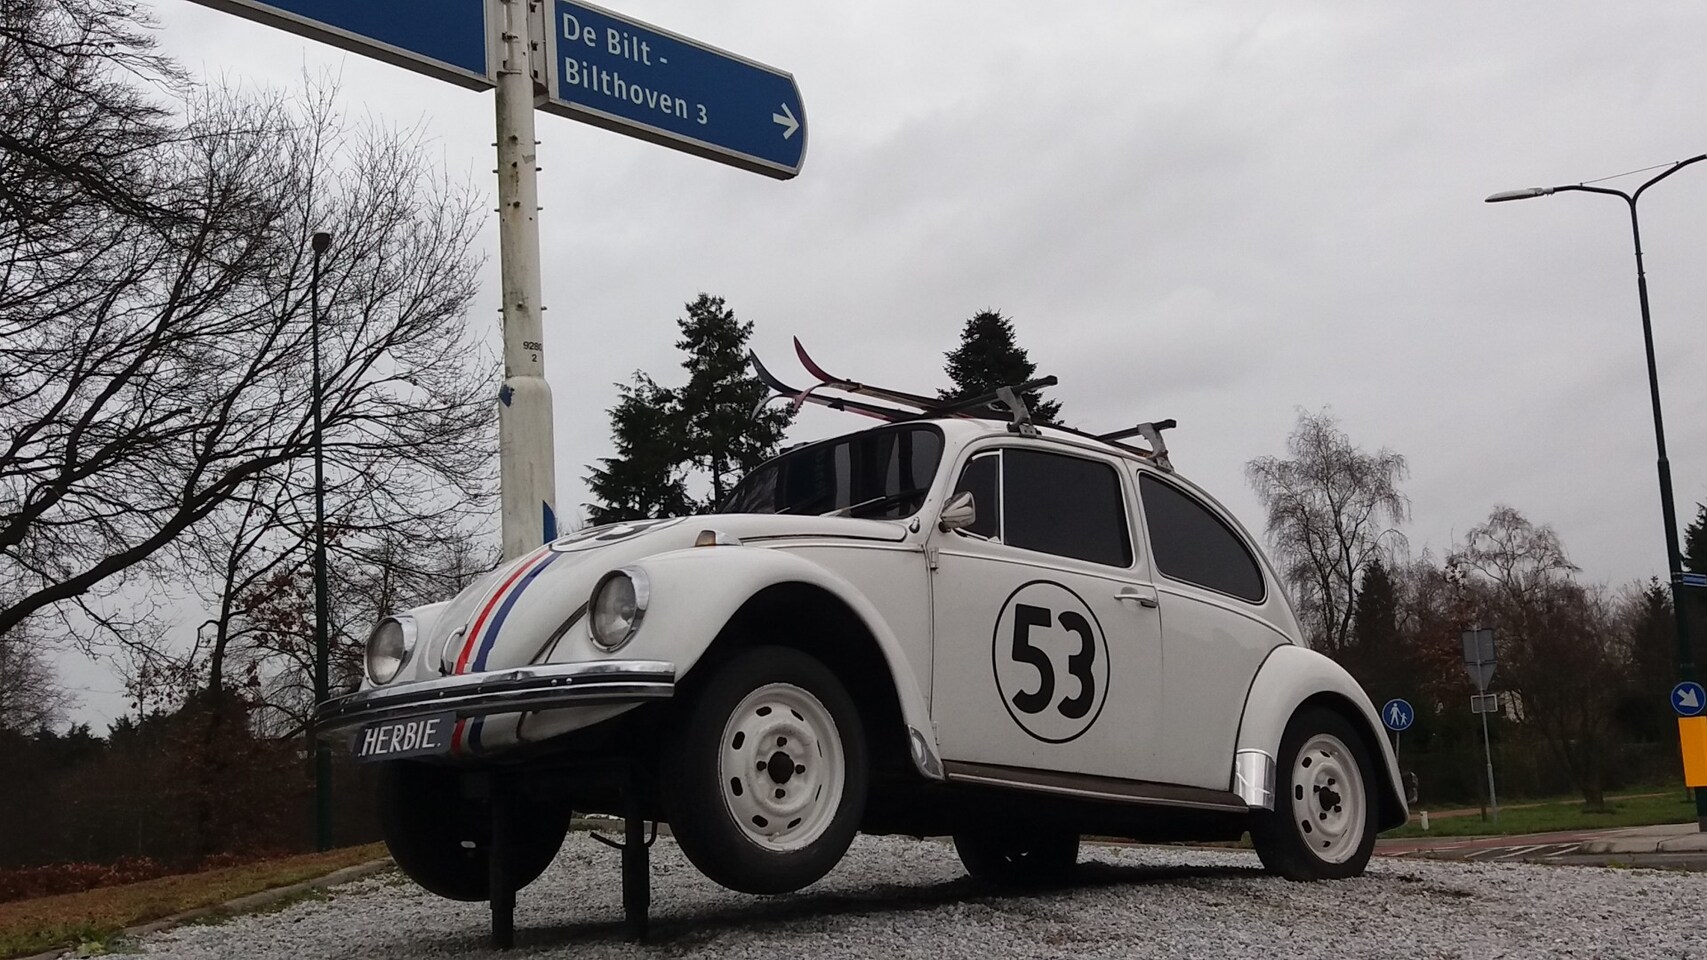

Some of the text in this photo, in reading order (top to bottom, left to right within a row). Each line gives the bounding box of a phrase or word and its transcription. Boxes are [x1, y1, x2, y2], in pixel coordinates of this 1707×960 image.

[563, 13, 597, 47] De
[607, 28, 651, 66] Bilt
[565, 57, 708, 125] Bilthoven 3
[531, 353, 538, 362] 2
[1012, 603, 1096, 719] 53
